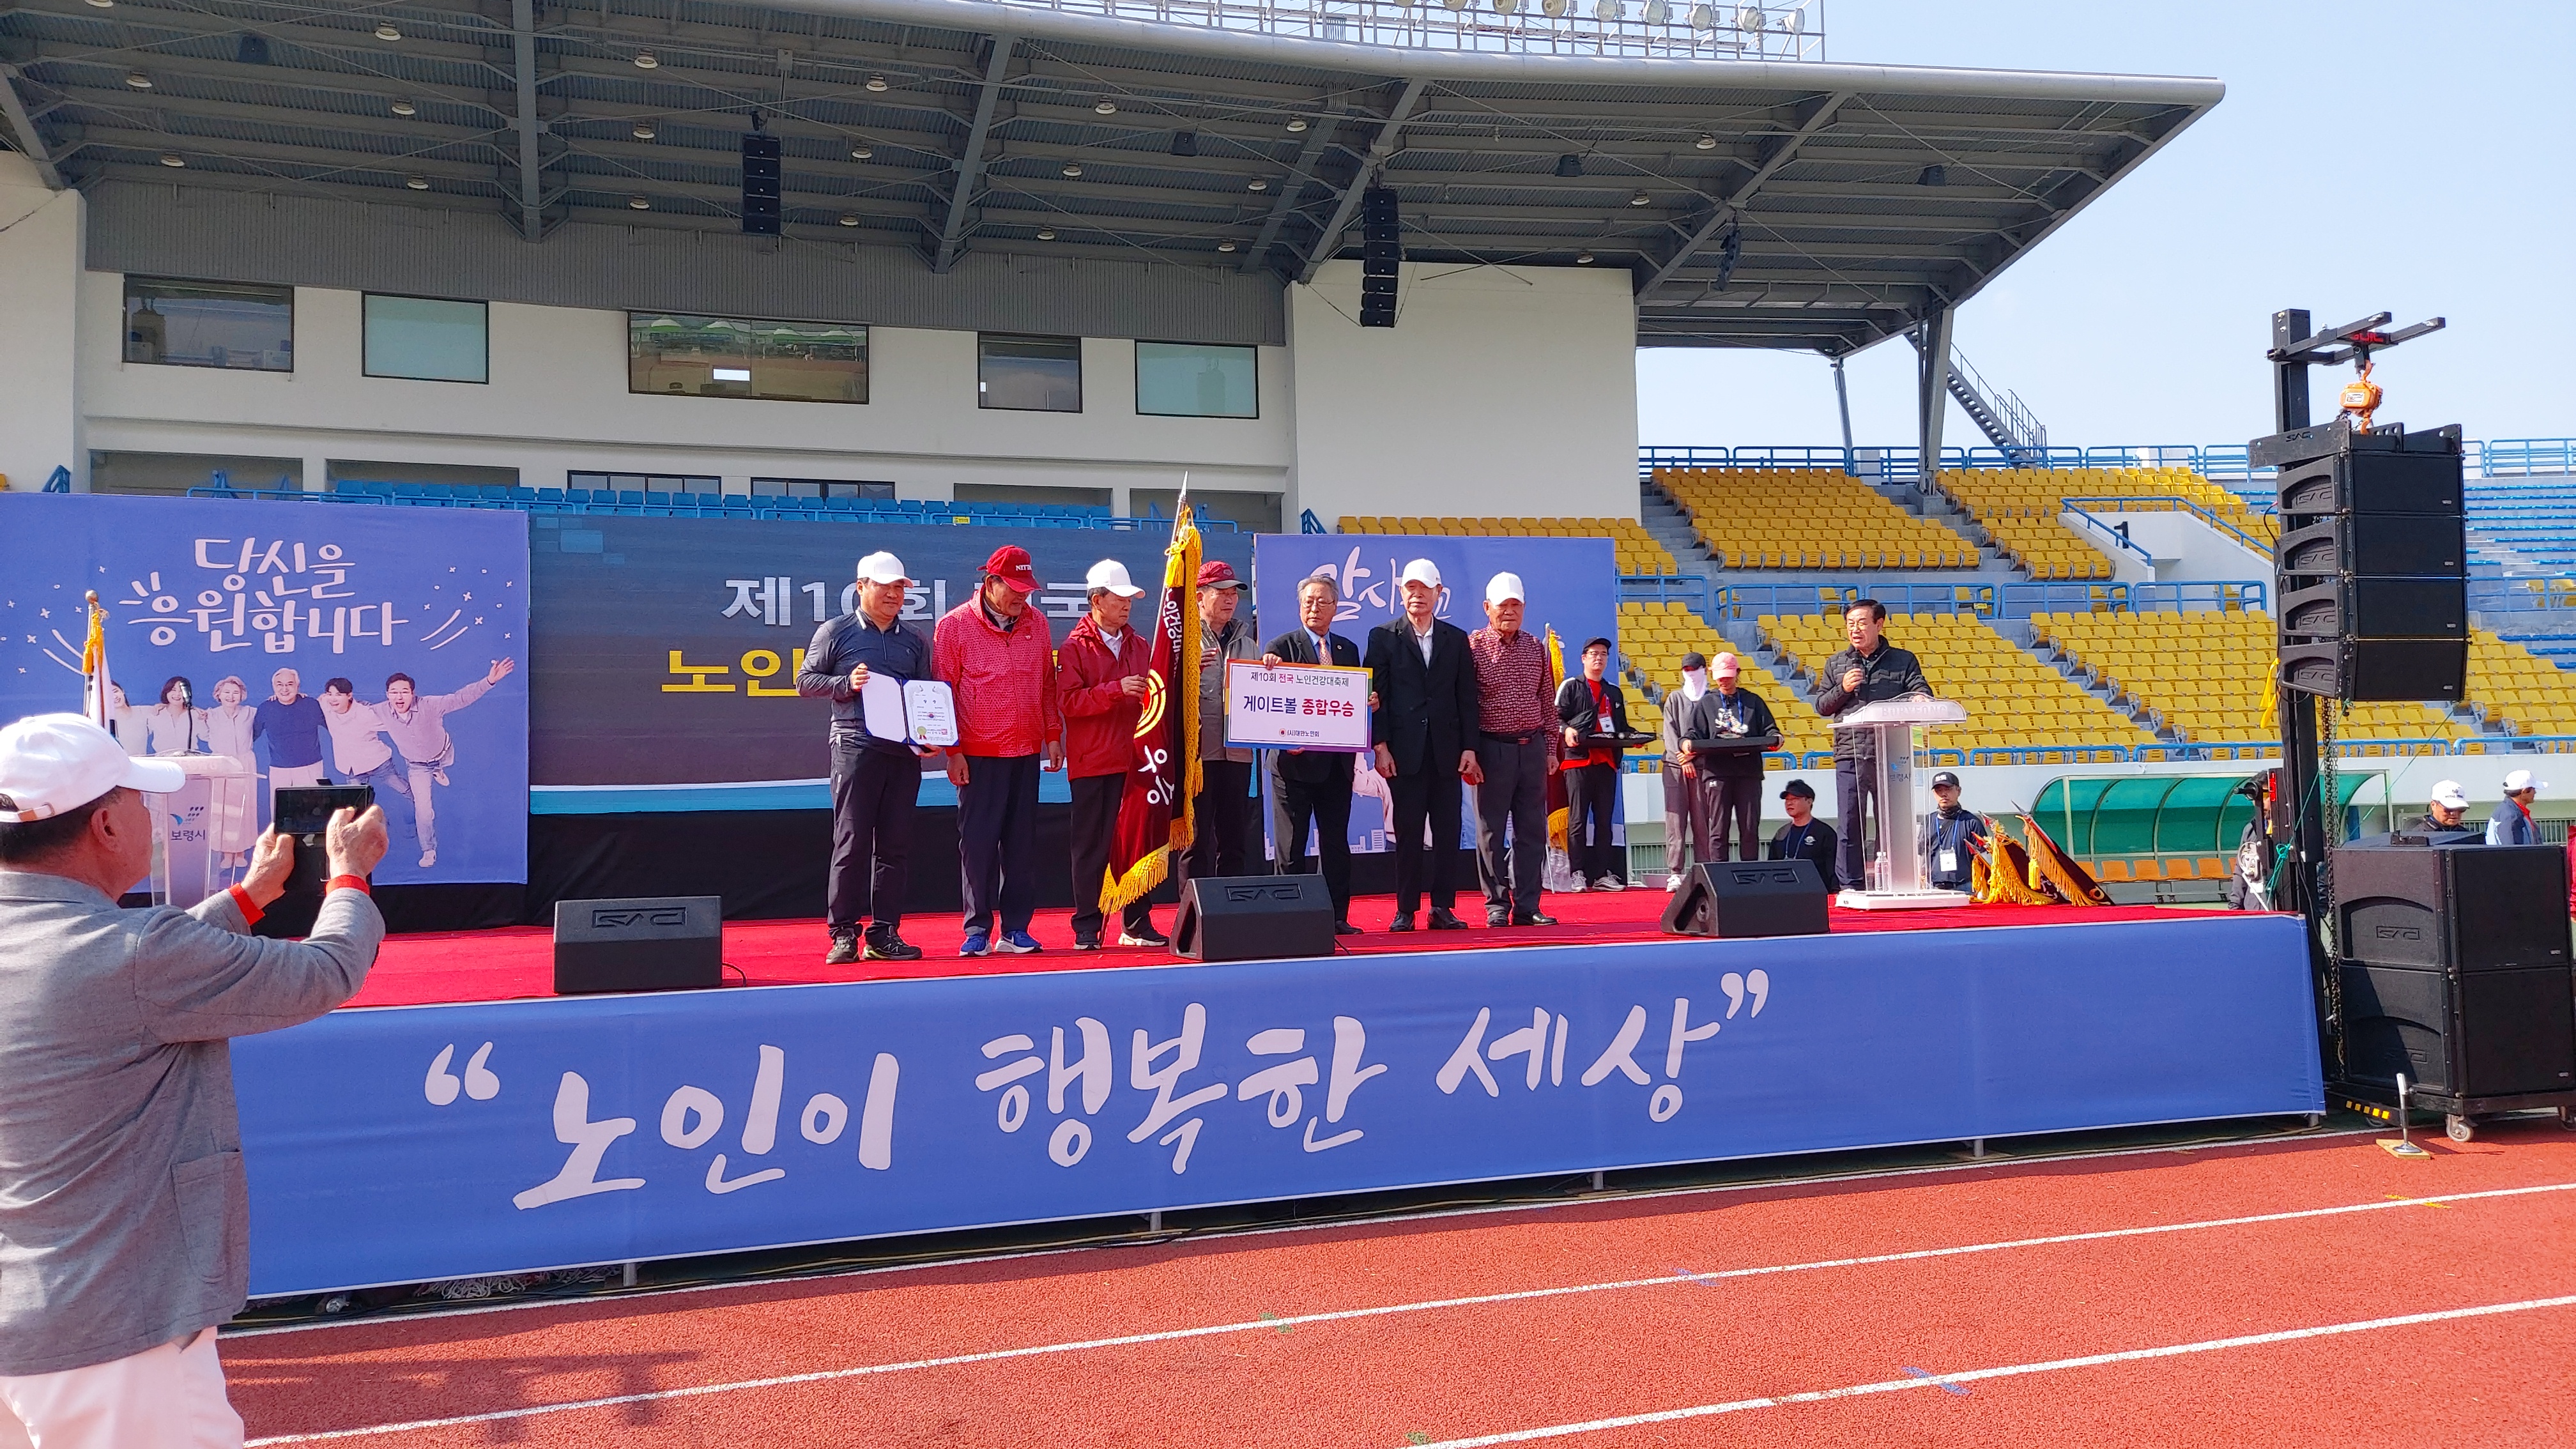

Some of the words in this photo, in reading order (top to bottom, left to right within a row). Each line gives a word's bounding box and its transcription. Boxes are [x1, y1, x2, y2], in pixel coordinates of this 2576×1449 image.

[2113, 521, 2129, 549] 1
[195, 537, 356, 599] 당신을
[128, 589, 410, 654] 응원합니다
[1250, 671, 1276, 682] 제10회
[1278, 673, 1294, 684] 전국
[1296, 675, 1349, 687] 노인건강대축제
[1243, 695, 1298, 714] 게이트볼
[1301, 698, 1355, 717] 종합우승
[1137, 744, 1175, 806] 우승
[171, 829, 206, 842] 보령시
[975, 1002, 1388, 1174] 행복한
